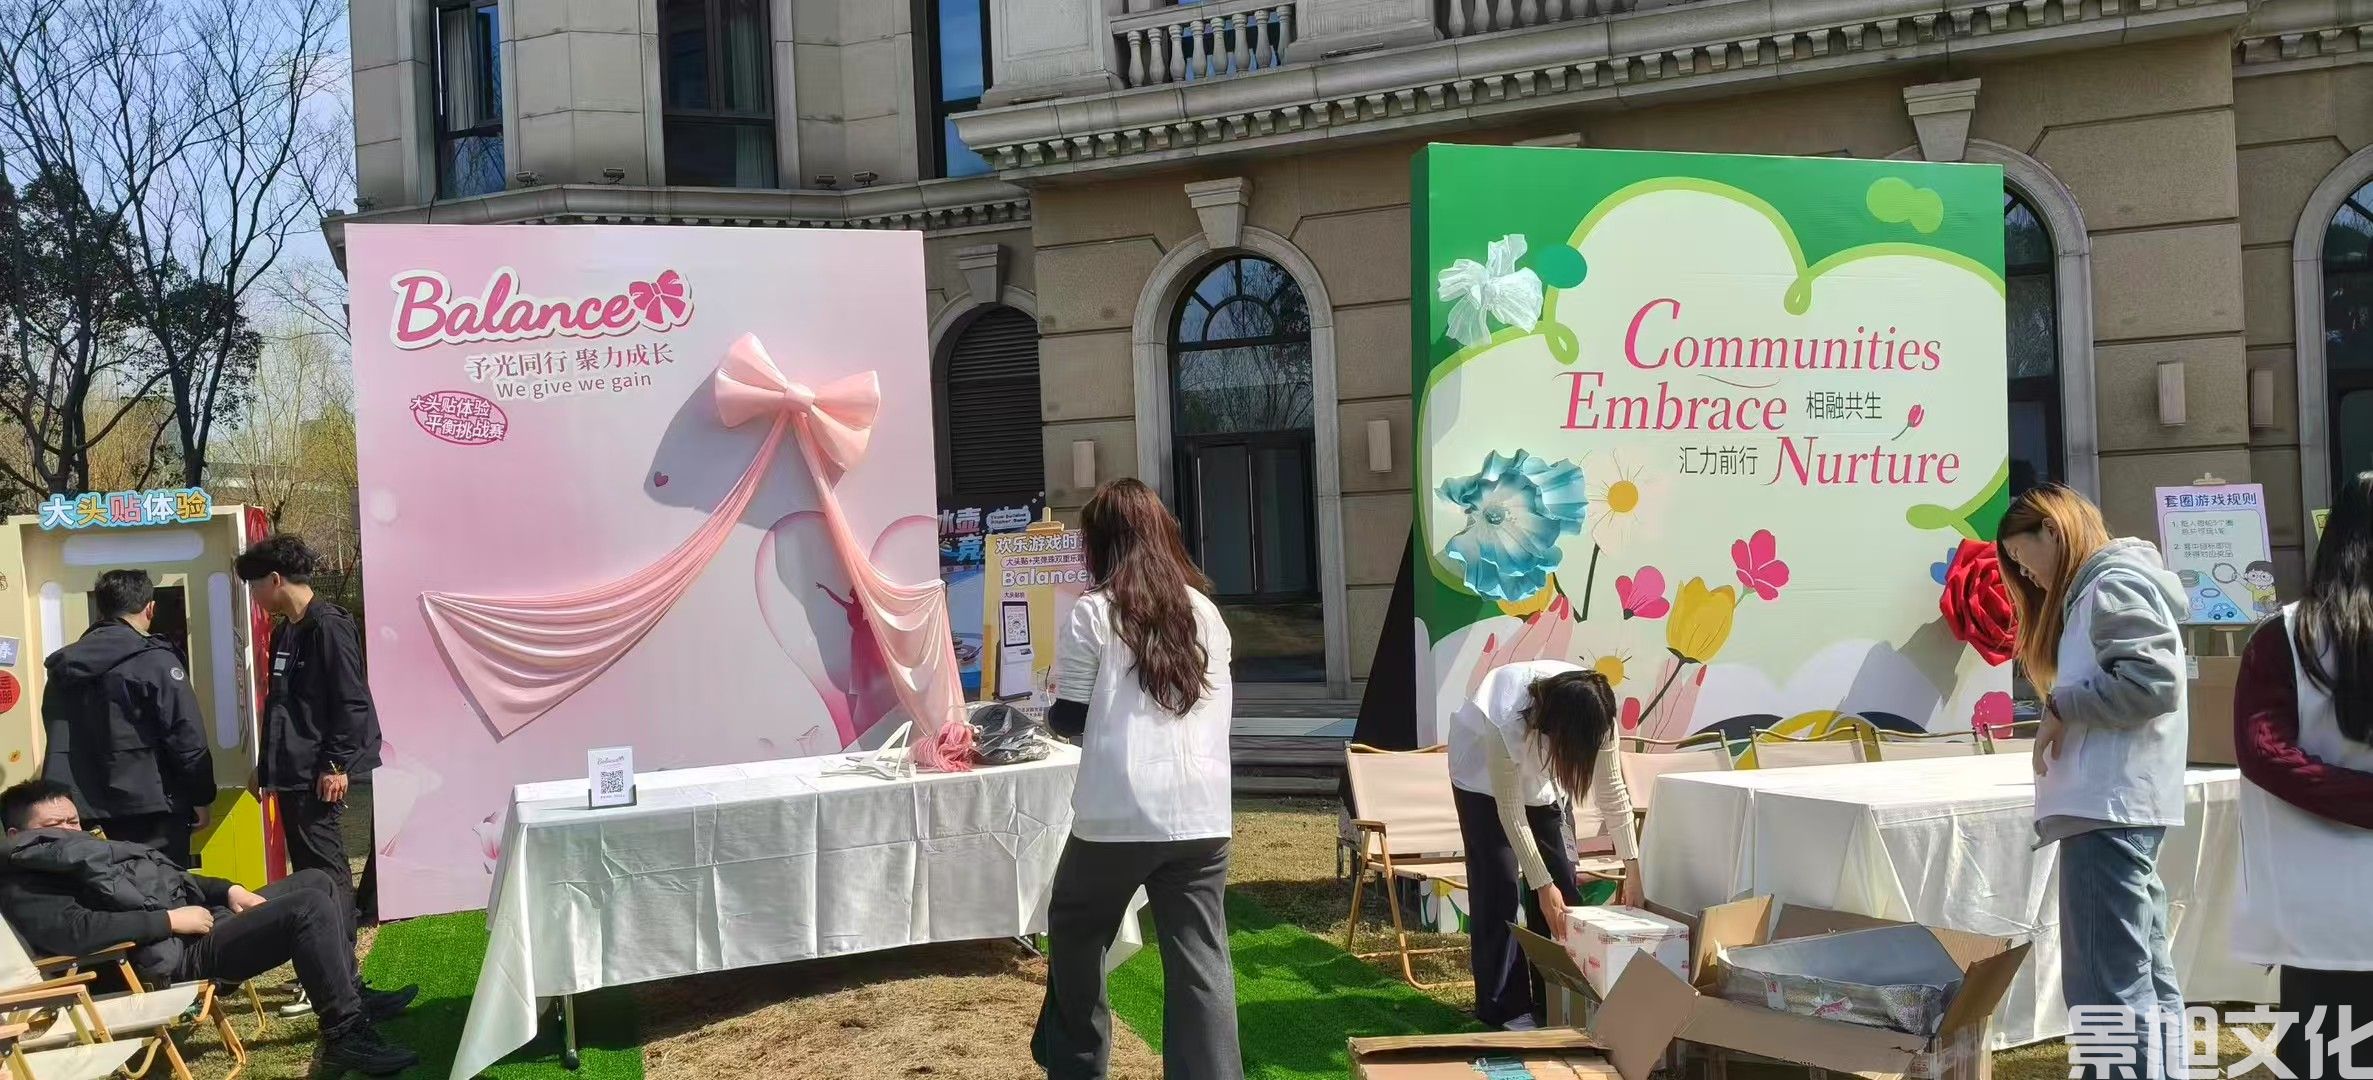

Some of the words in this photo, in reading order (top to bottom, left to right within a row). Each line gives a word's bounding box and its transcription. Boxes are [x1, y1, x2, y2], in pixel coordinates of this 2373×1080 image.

[397, 272, 635, 342] Balance
[1623, 298, 1941, 371] Communities
[464, 350, 568, 381] 予光同行
[575, 343, 675, 371] 聚力成长
[496, 382, 526, 398] We
[532, 377, 573, 399] give
[579, 379, 606, 392] we
[611, 372, 652, 391] gain
[1553, 371, 1787, 431] Embrace
[410, 394, 491, 418] 大头贴体验
[1806, 391, 1883, 421] 相融共生
[425, 413, 505, 441] 平衡挑战赛
[1678, 445, 1759, 476] 汇力前行
[1764, 435, 1960, 487] Nurture
[41, 491, 208, 527] 大头贴体验
[2164, 492, 2257, 508] 套圈游戏规则
[995, 532, 1083, 554] 欢乐游戏时
